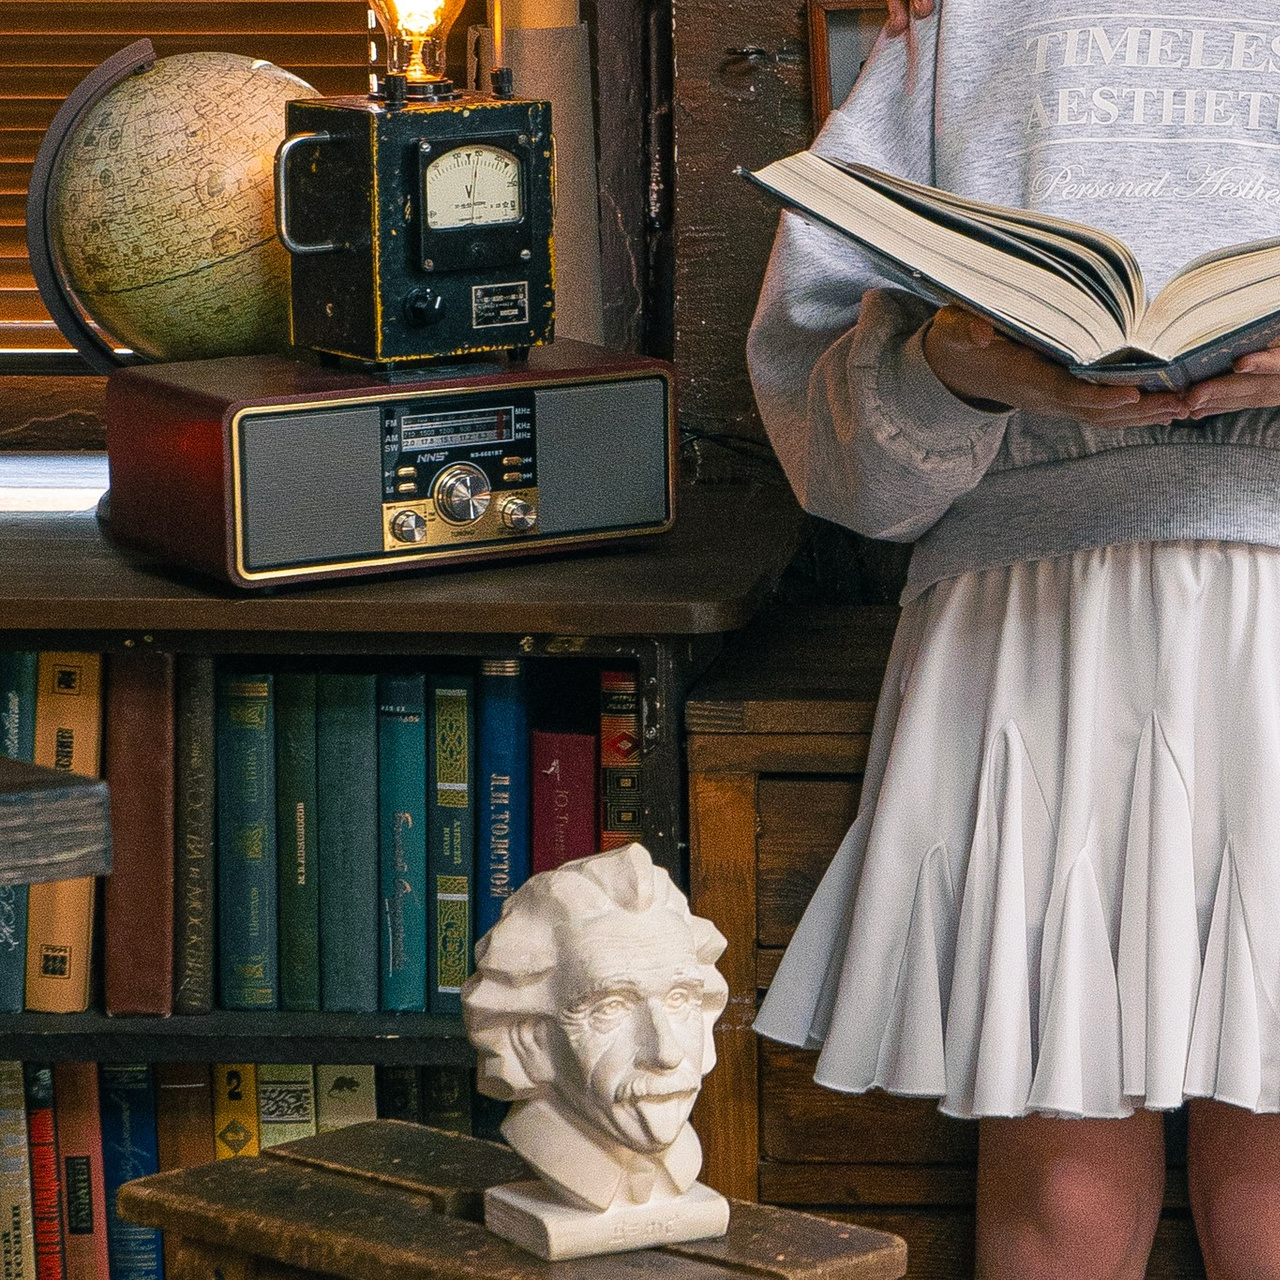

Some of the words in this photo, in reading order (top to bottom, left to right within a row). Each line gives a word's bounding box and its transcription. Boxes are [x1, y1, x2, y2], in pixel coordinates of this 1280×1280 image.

[1030, 163, 1170, 204] Personal
[465, 184, 472, 199] V
[515, 407, 531, 415] MHz
[385, 419, 397, 427] FM
[515, 422, 531, 430] KHz
[384, 434, 398, 443] AM
[384, 444, 398, 453] SW
[226, 1069, 243, 1101] 2
[12, 1205, 23, 1279] ЕСЕНИН
